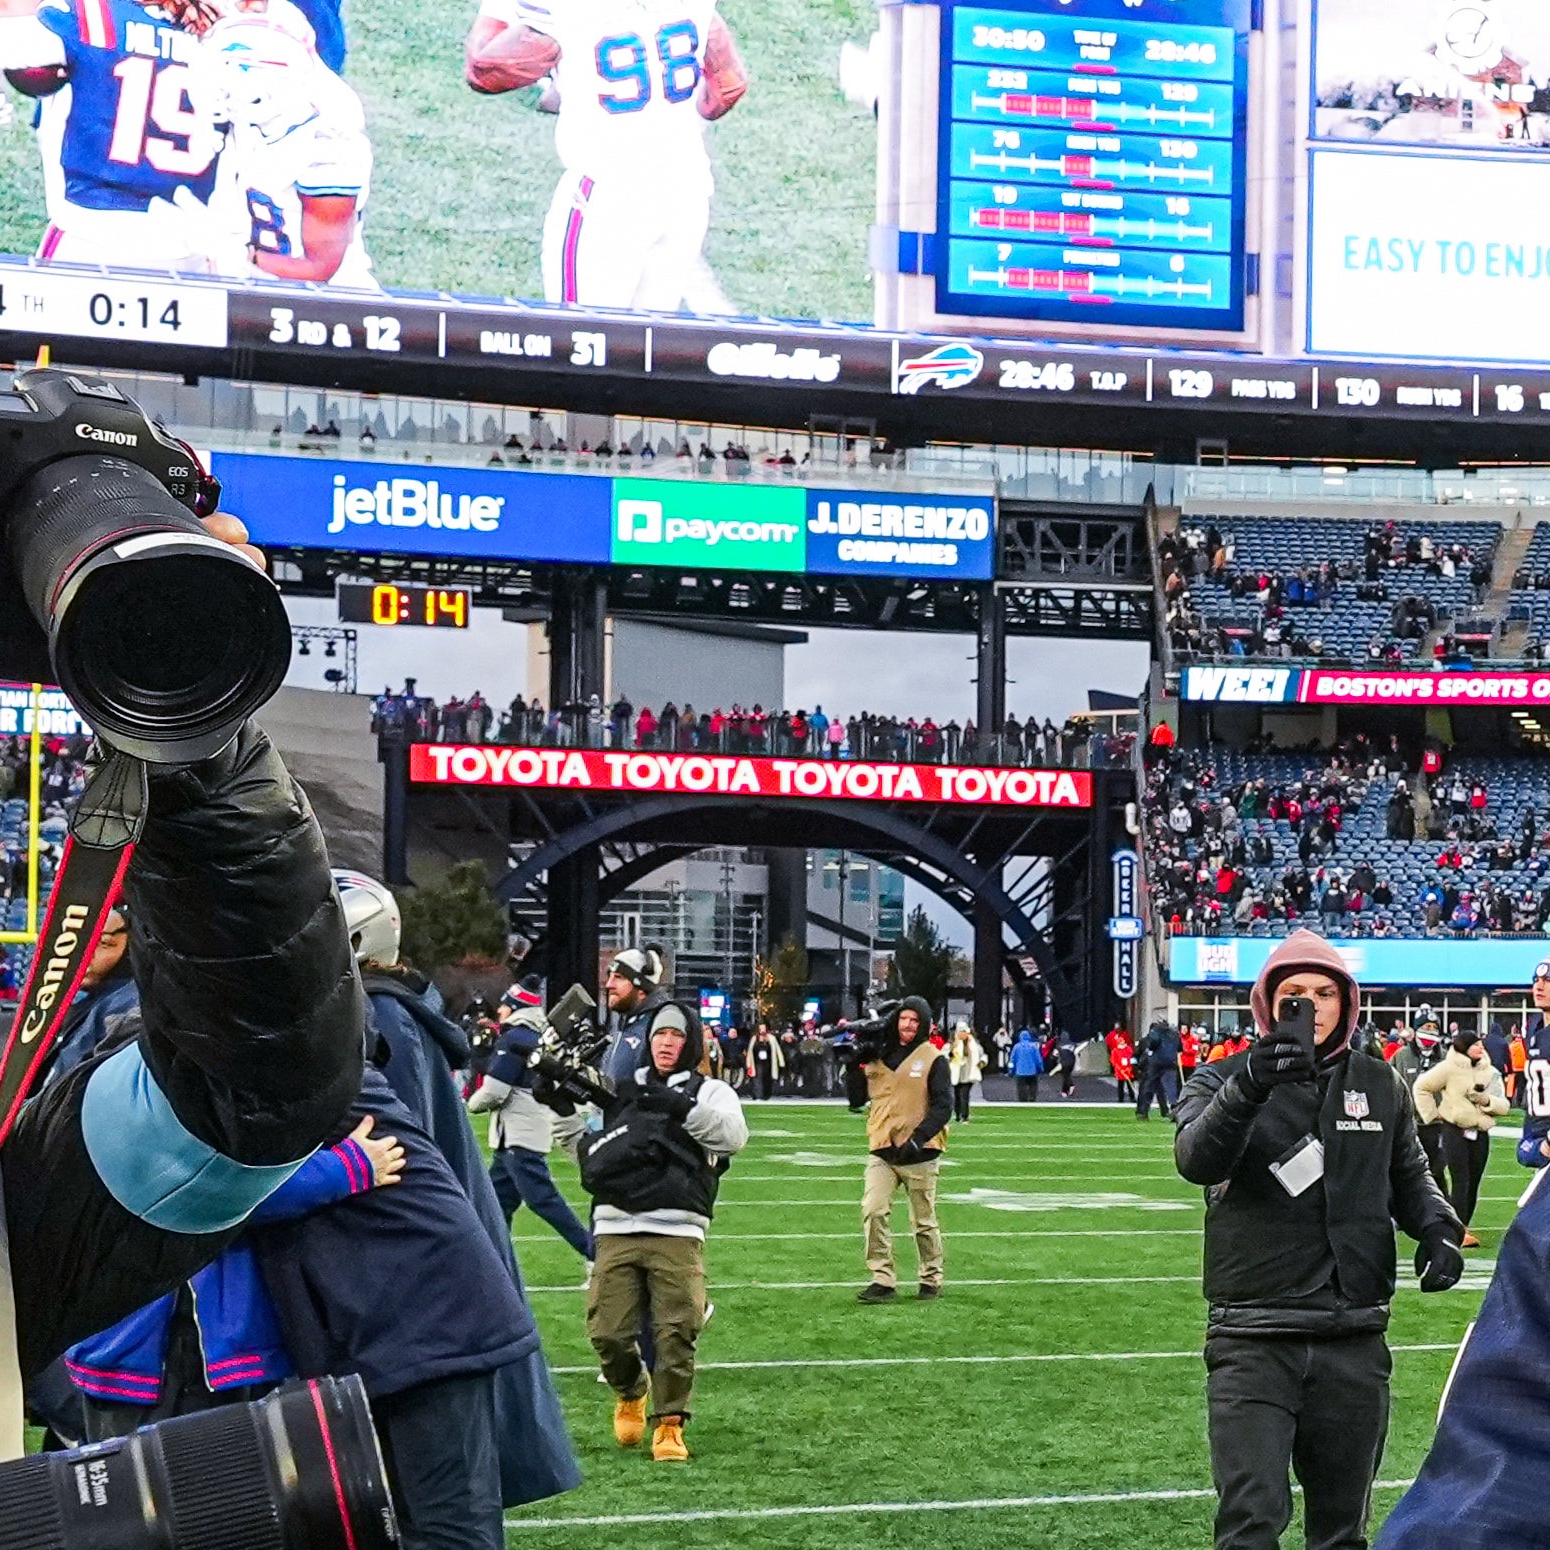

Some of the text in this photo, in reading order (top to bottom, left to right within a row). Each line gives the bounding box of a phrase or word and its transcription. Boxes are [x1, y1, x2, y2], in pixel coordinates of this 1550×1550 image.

[594, 18, 701, 115] 98
[107, 55, 216, 177] 19
[1343, 235, 1425, 272] EASY
[1435, 240, 1476, 276] TO
[22, 293, 44, 314] TH
[88, 292, 183, 332] 0:14
[269, 307, 295, 347] 3
[363, 315, 402, 353] 12
[480, 330, 606, 367] BALL ON 31
[1000, 358, 1076, 391] 28:46
[1169, 370, 1214, 398] 129
[1335, 377, 1381, 407] 130
[1495, 384, 1525, 413] 16
[75, 423, 138, 448] Canon
[168, 466, 189, 477] EOS
[171, 483, 186, 495] R3
[328, 475, 505, 534] jetBlue
[808, 501, 988, 542] J.DERENZO
[665, 515, 799, 546] paycom
[837, 540, 958, 567] COMPANIES
[372, 584, 464, 627] 0:14
[1186, 666, 1292, 701] WEEI
[1315, 676, 1434, 698] BOSTON'S
[1436, 676, 1529, 698] SPORTS
[429, 745, 1079, 805] TOYOTA TOYOTA TOYOTA TOYOTA
[19, 903, 90, 1045] Canon
[1121, 942, 1131, 990] HALL
[1347, 1102, 1365, 1113] NFL
